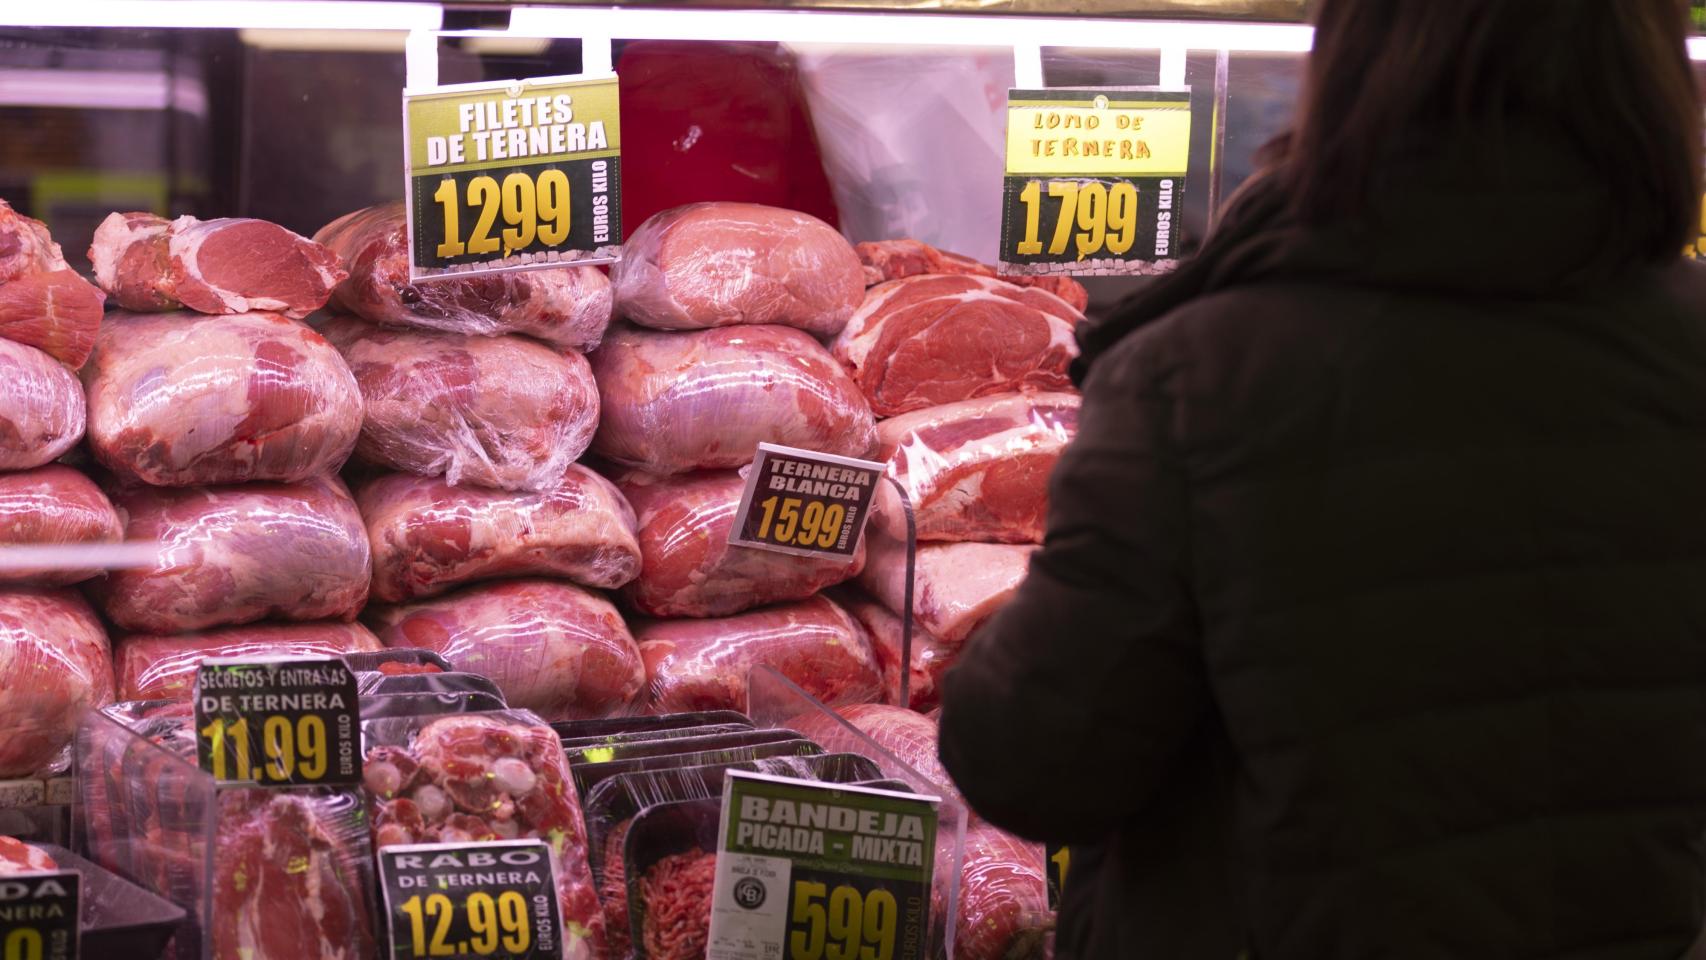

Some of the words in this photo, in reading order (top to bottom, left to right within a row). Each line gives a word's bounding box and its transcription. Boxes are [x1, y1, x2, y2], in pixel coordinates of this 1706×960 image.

[459, 94, 573, 133] FILETES
[1034, 112, 1099, 130] LOMO
[1116, 114, 1144, 131] DE
[427, 134, 465, 166] DE
[473, 121, 608, 160] TERNERA
[1030, 138, 1151, 160] TERNERA
[592, 160, 608, 193] KILO
[1158, 179, 1174, 209] KILO
[592, 195, 609, 243] EUROS
[1155, 211, 1172, 256] EUROS
[769, 475, 860, 501] BLANCA
[770, 458, 870, 486] TERNERA
[757, 496, 844, 548] 15,99
[837, 524, 851, 550] EUROS
[846, 506, 858, 524] KILO
[200, 669, 265, 690] SECRETOS
[202, 695, 232, 713] DE
[239, 693, 345, 712] TERNERA
[337, 714, 351, 739] KILO
[201, 715, 327, 782] 11.99
[339, 741, 353, 775] EUROS
[740, 795, 925, 841] BANDEJA
[394, 850, 540, 869] RABO
[736, 821, 825, 854] PICADA
[852, 835, 923, 866] MIXTA
[398, 875, 429, 888] DE
[434, 871, 541, 887] TERNERA
[533, 894, 550, 918] KILO
[400, 890, 530, 957] 12.99
[536, 919, 553, 951] EUROS
